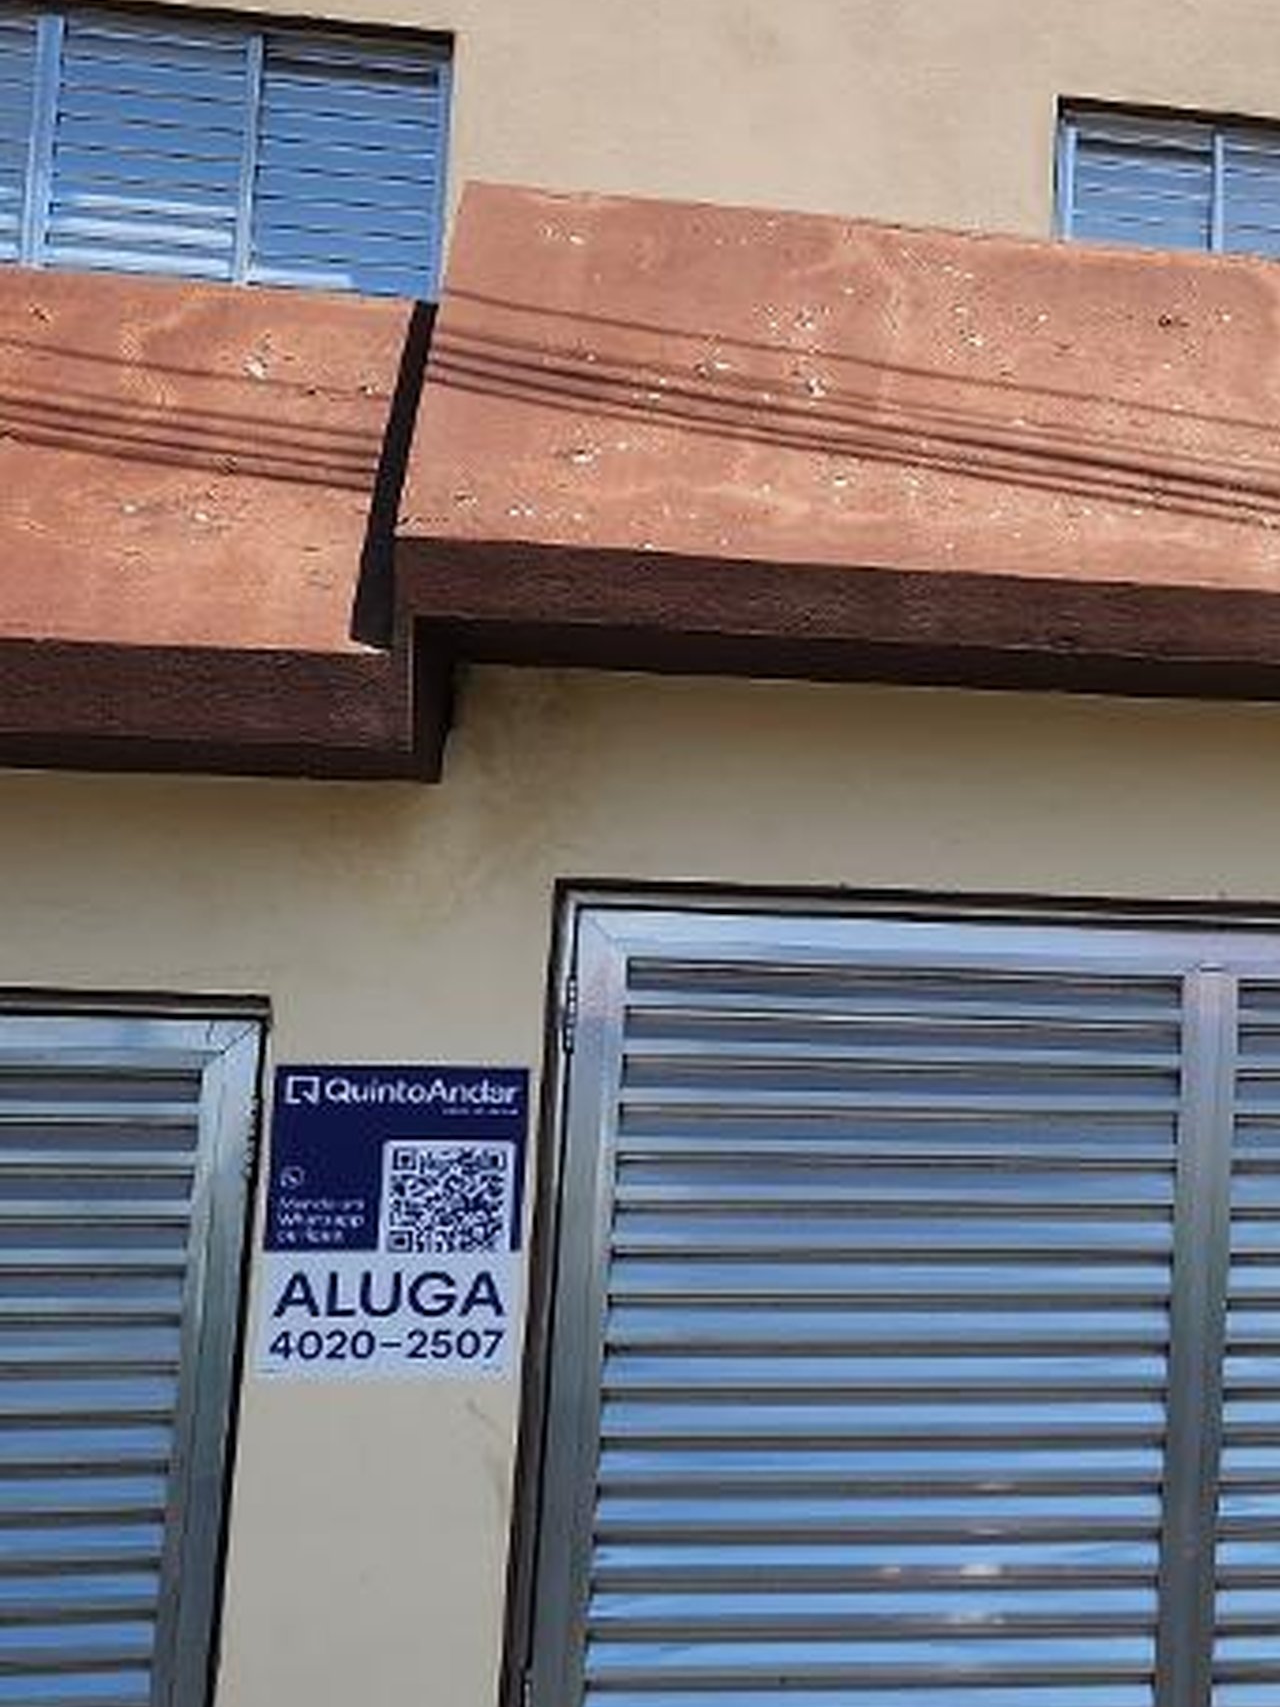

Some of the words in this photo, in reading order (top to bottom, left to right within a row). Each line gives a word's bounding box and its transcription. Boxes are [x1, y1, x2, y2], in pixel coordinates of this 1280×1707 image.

[325, 1077, 518, 1105] QuintoAndar
[274, 1271, 506, 1318] ALUGA
[269, 1330, 506, 1360] 4020-2507
